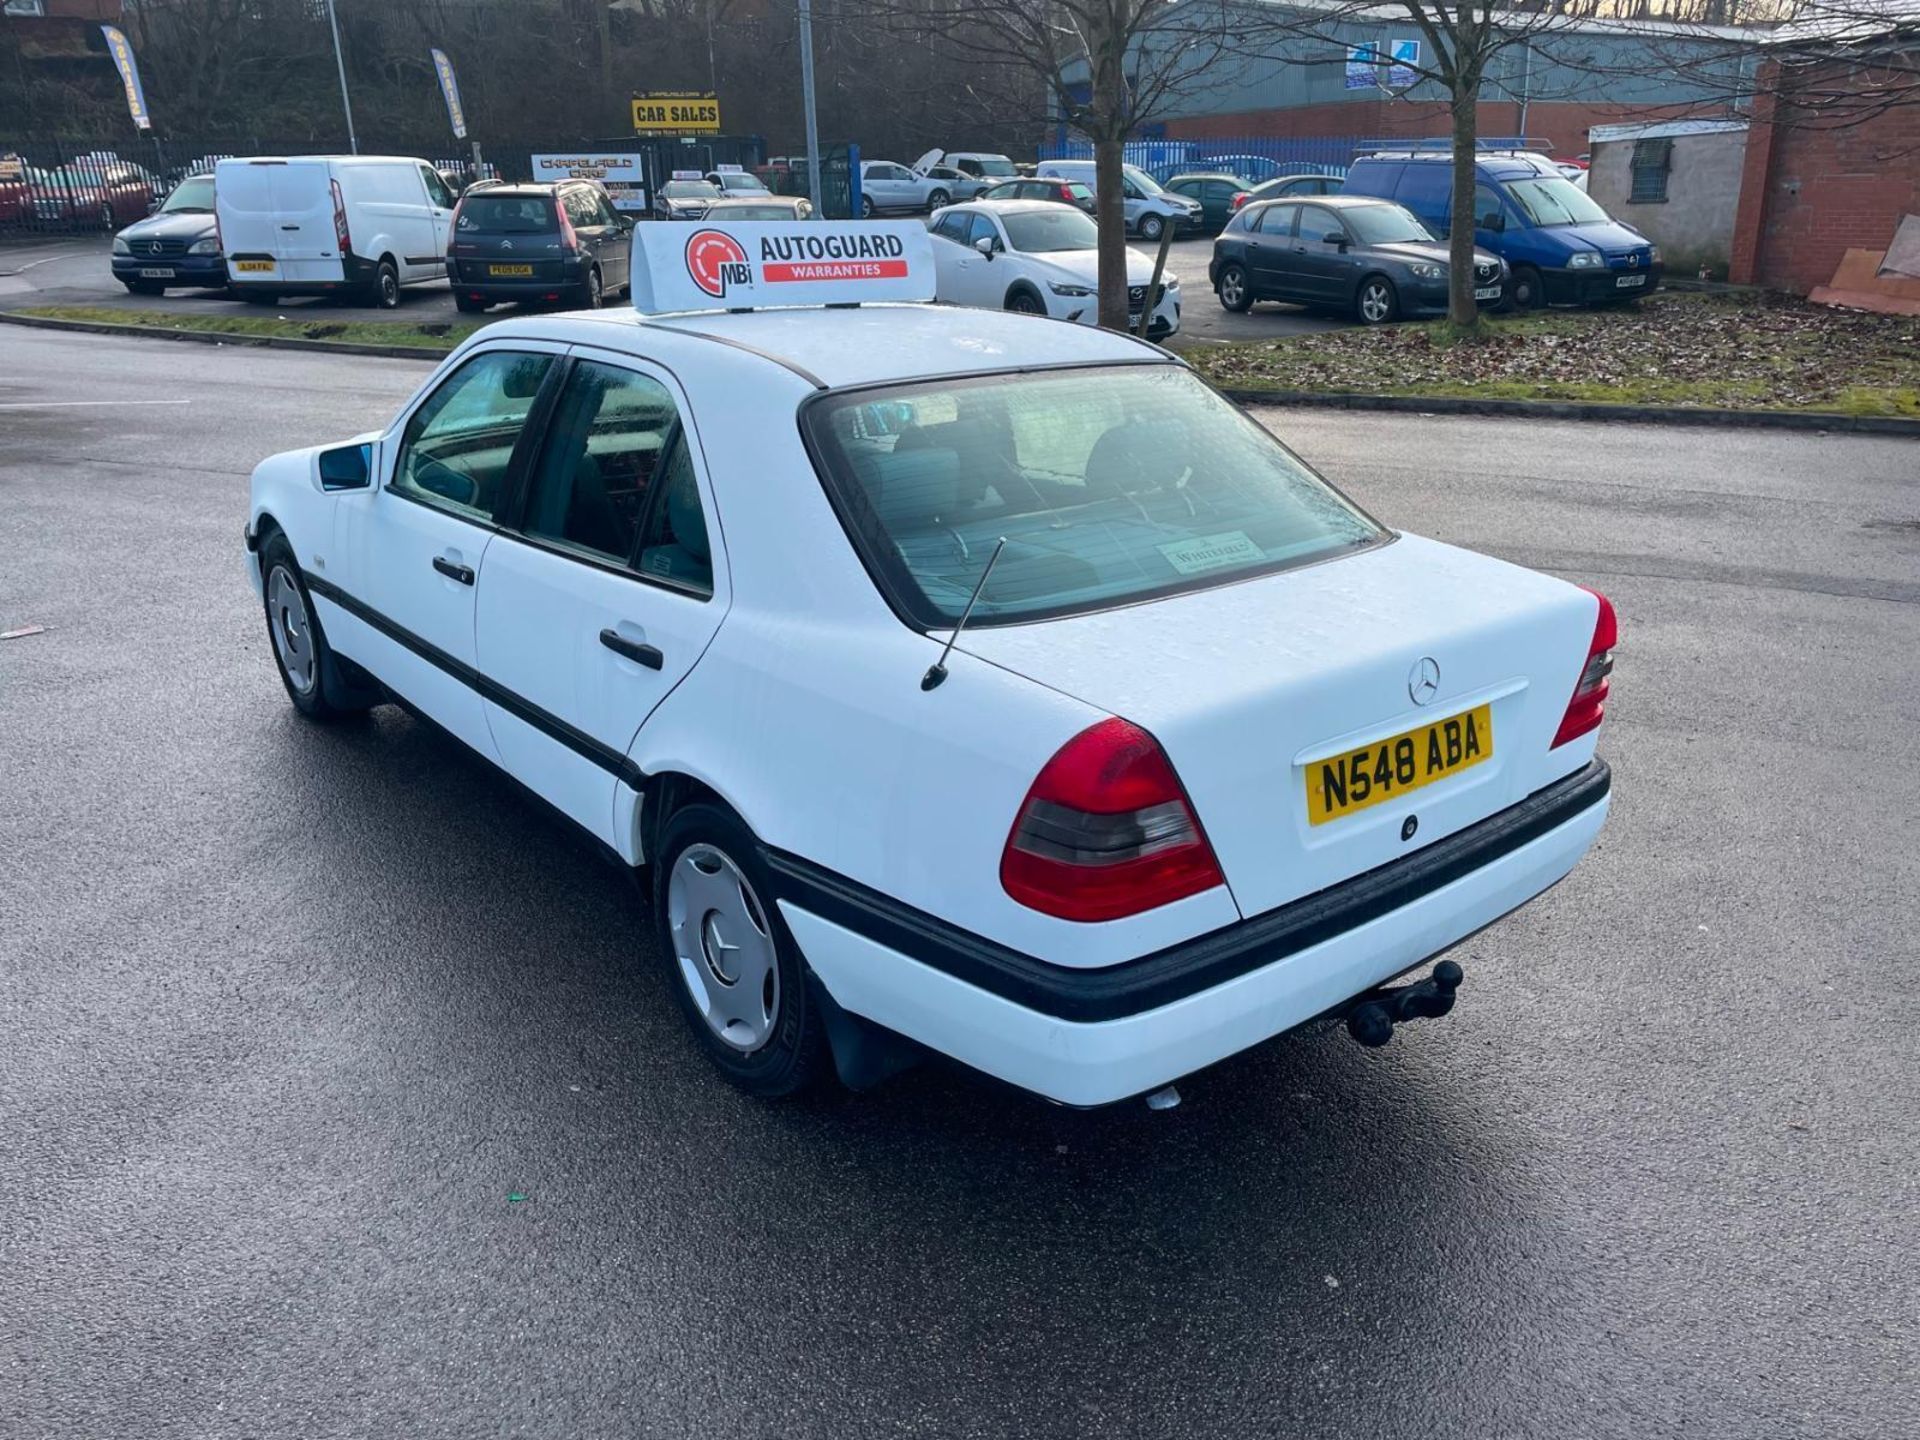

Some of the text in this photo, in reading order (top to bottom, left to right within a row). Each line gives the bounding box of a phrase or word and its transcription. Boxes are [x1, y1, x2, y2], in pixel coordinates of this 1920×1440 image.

[637, 106, 717, 122] CAR SALES
[540, 158, 633, 169] CHAPELFIELD
[569, 168, 608, 179] CARS
[761, 234, 904, 261] AUTOGUARD
[791, 263, 882, 279] WARRANTIES
[1322, 713, 1481, 813] N548 ABA
